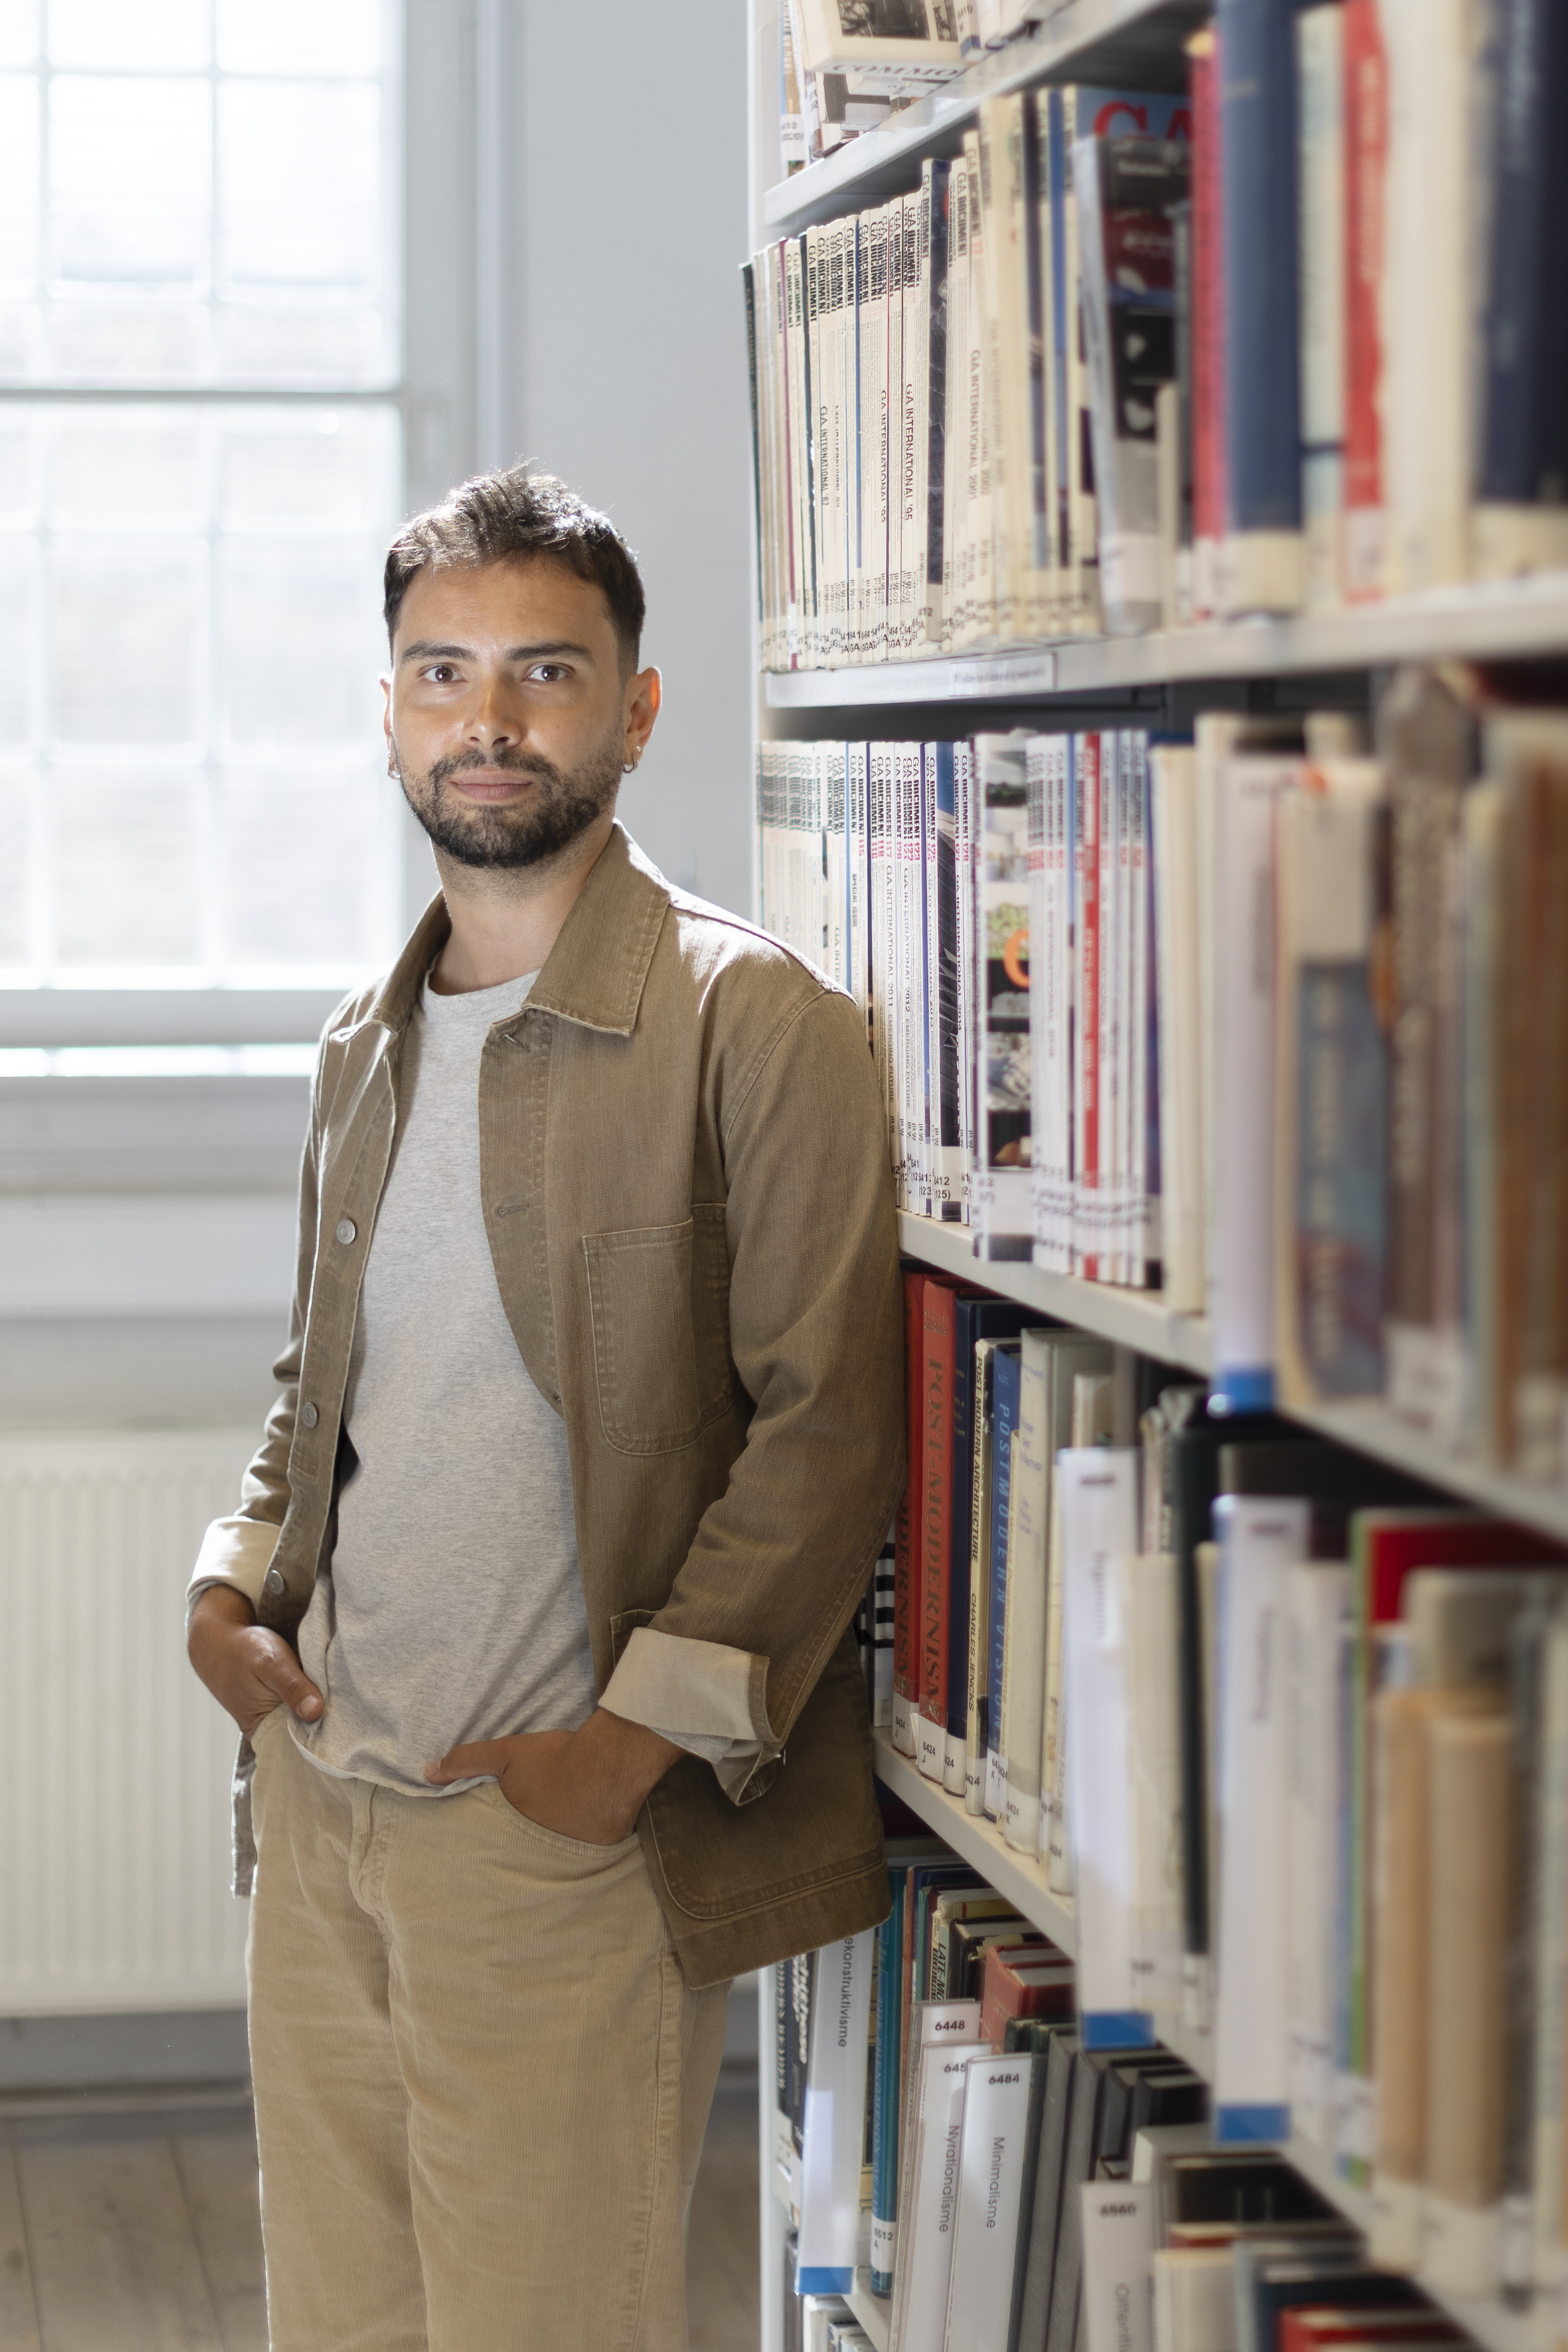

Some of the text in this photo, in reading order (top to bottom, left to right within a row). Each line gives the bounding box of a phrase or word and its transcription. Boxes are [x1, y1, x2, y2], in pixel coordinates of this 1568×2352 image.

[957, 196, 967, 258] DOCUMENT
[847, 228, 854, 248] GA
[809, 245, 816, 264] GA
[971, 349, 980, 373] GA
[881, 390, 888, 411] GA
[905, 384, 914, 405] GA
[821, 406, 828, 426] GA
[969, 374, 980, 473] INTERNATIONAL
[820, 428, 829, 492] INTERNATIONAL
[905, 407, 914, 499] INTERNATIONAL
[877, 757, 884, 777] GA
[886, 757, 891, 777] GA
[913, 757, 919, 777] GA
[962, 755, 968, 776] GA
[886, 865, 892, 886] GA
[903, 868, 909, 888] GA
[972, 1460, 980, 1563] ARCHITECTURE
[997, 1402, 1010, 1604] POSTMODERN
[923, 1741, 935, 1755] 6424
[922, 1755, 925, 1763] J
[991, 1770, 995, 1779] K
[838, 1937, 854, 2048] ekonstruktivisme
[935, 2020, 965, 2031] 6448
[988, 2073, 1020, 2084] 6484
[939, 2125, 961, 2233] Nyrationalisme
[986, 2136, 1005, 2229] Minimalisme
